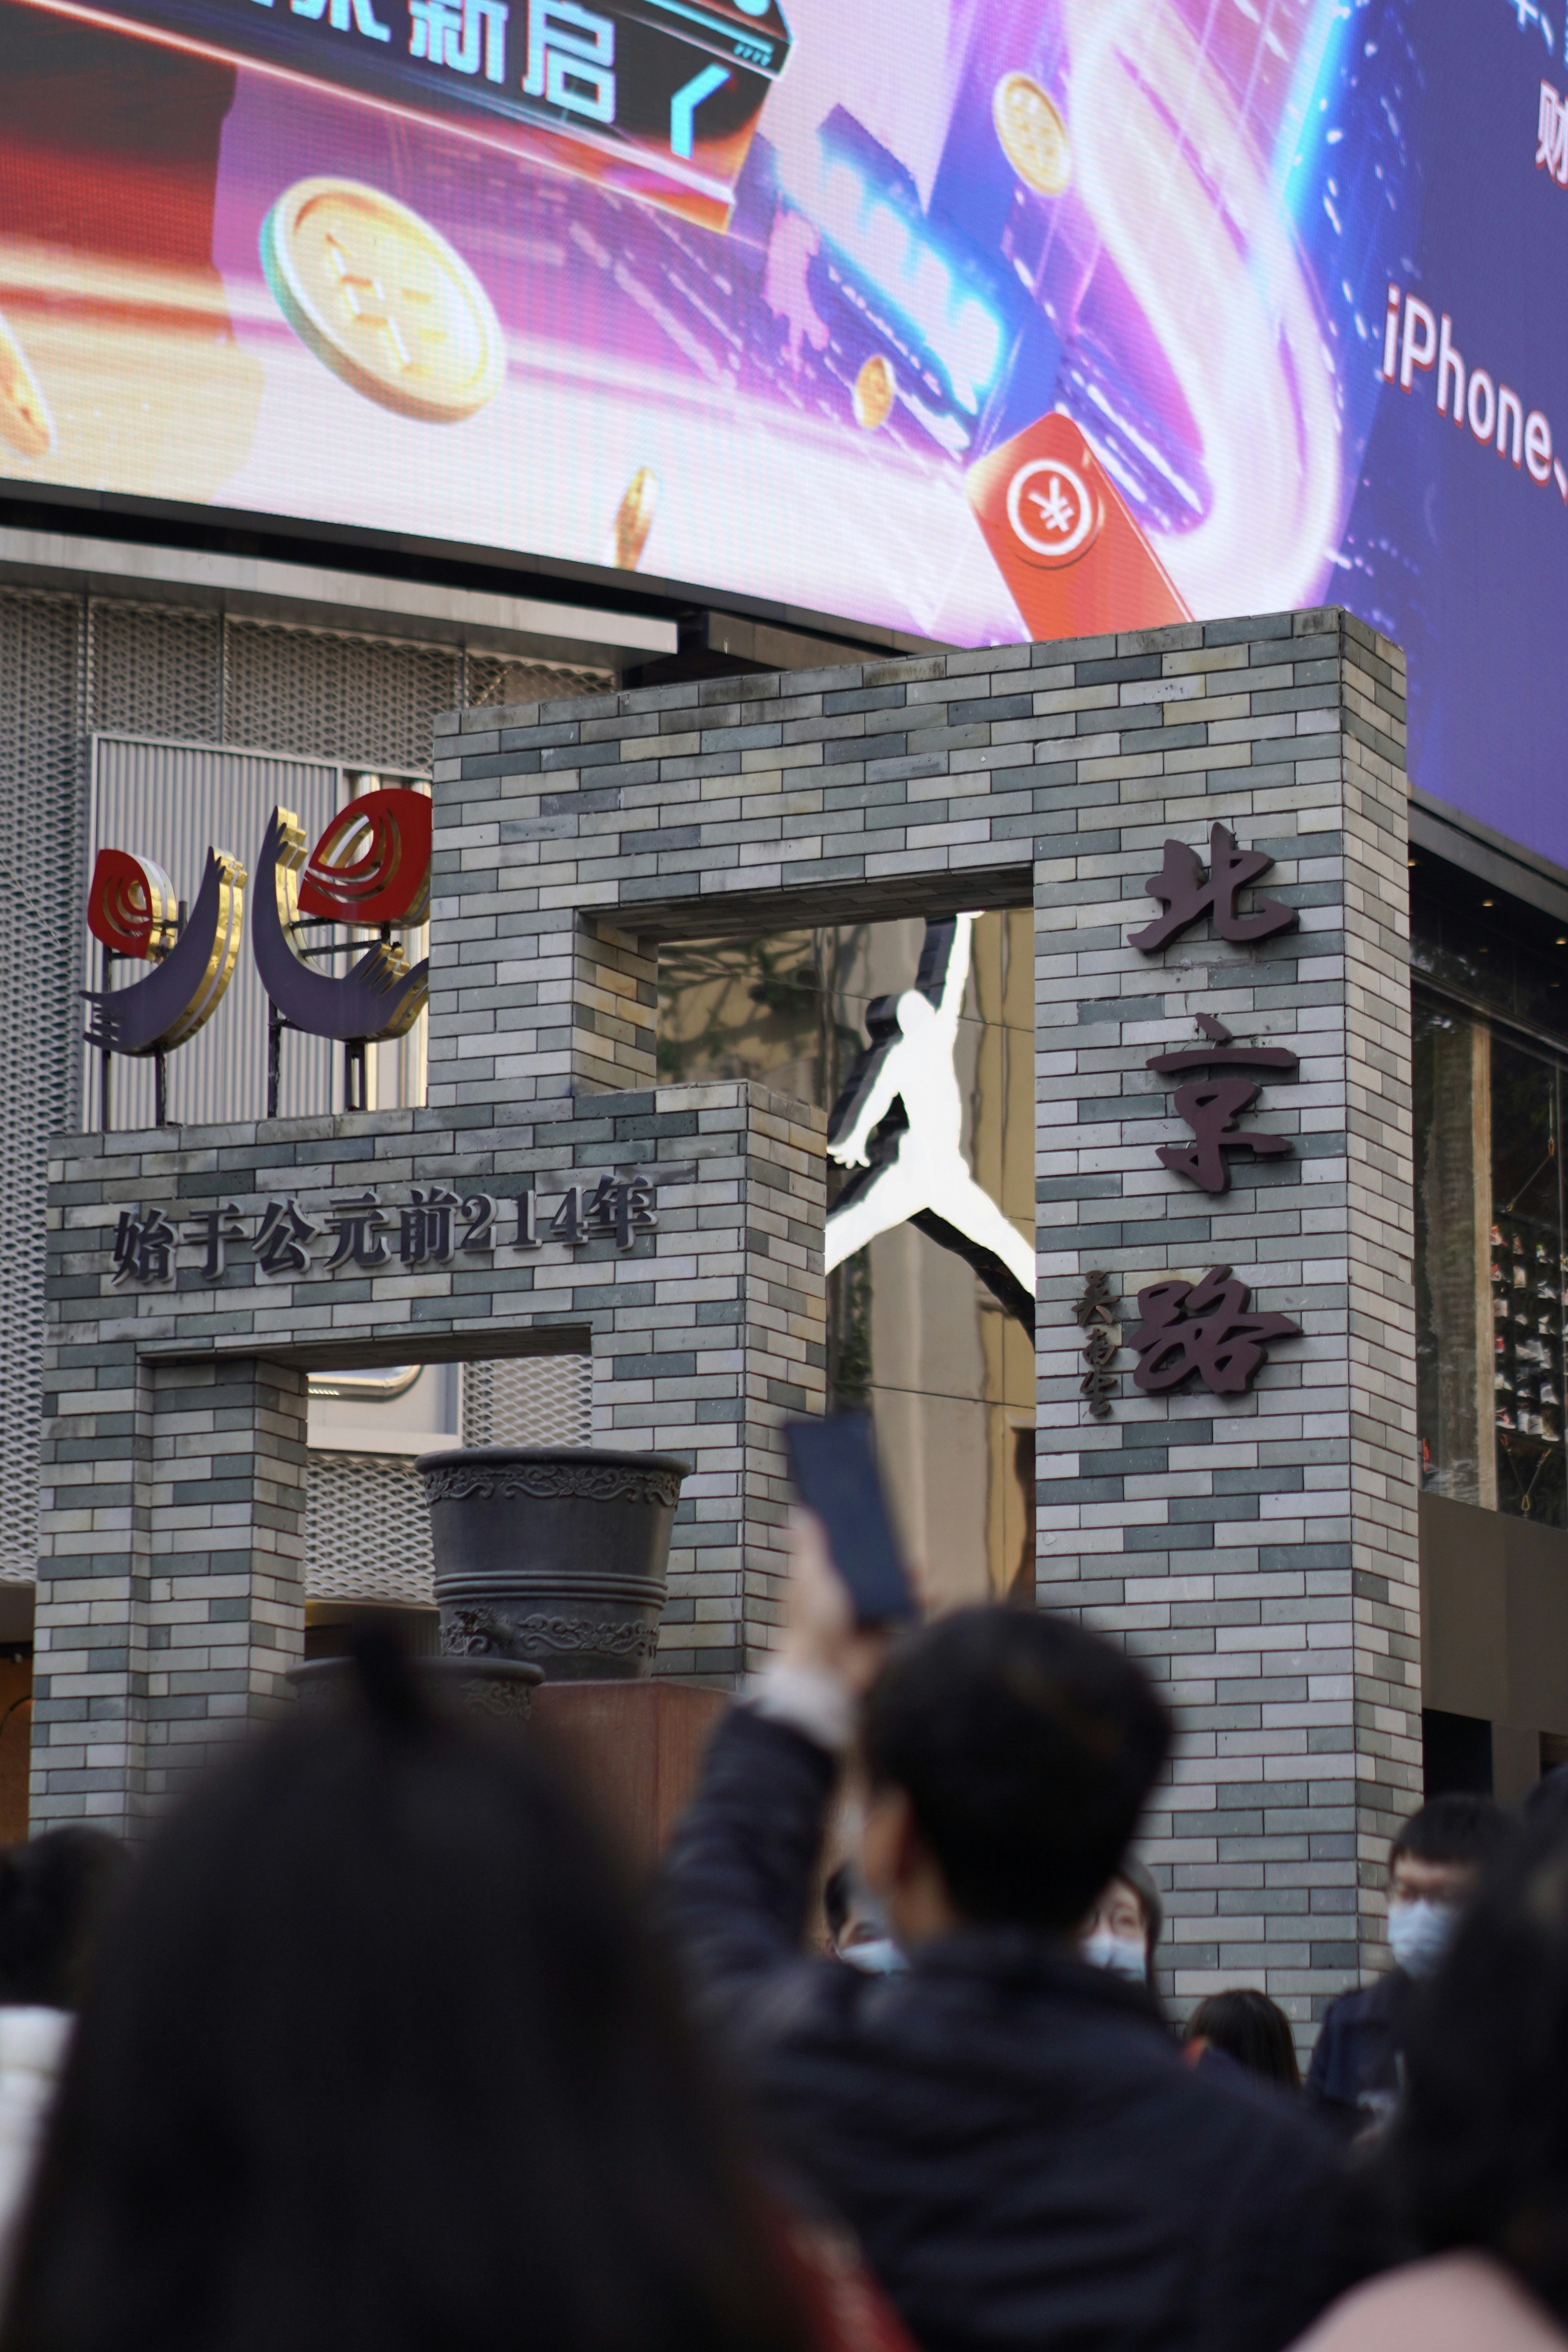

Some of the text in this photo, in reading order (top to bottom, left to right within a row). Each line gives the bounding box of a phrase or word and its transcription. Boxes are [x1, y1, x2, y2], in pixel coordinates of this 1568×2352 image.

[251, 0, 616, 123] 新启
[1128, 822, 1303, 1393] 北京路
[111, 1174, 658, 1286] 始于公元前214年
